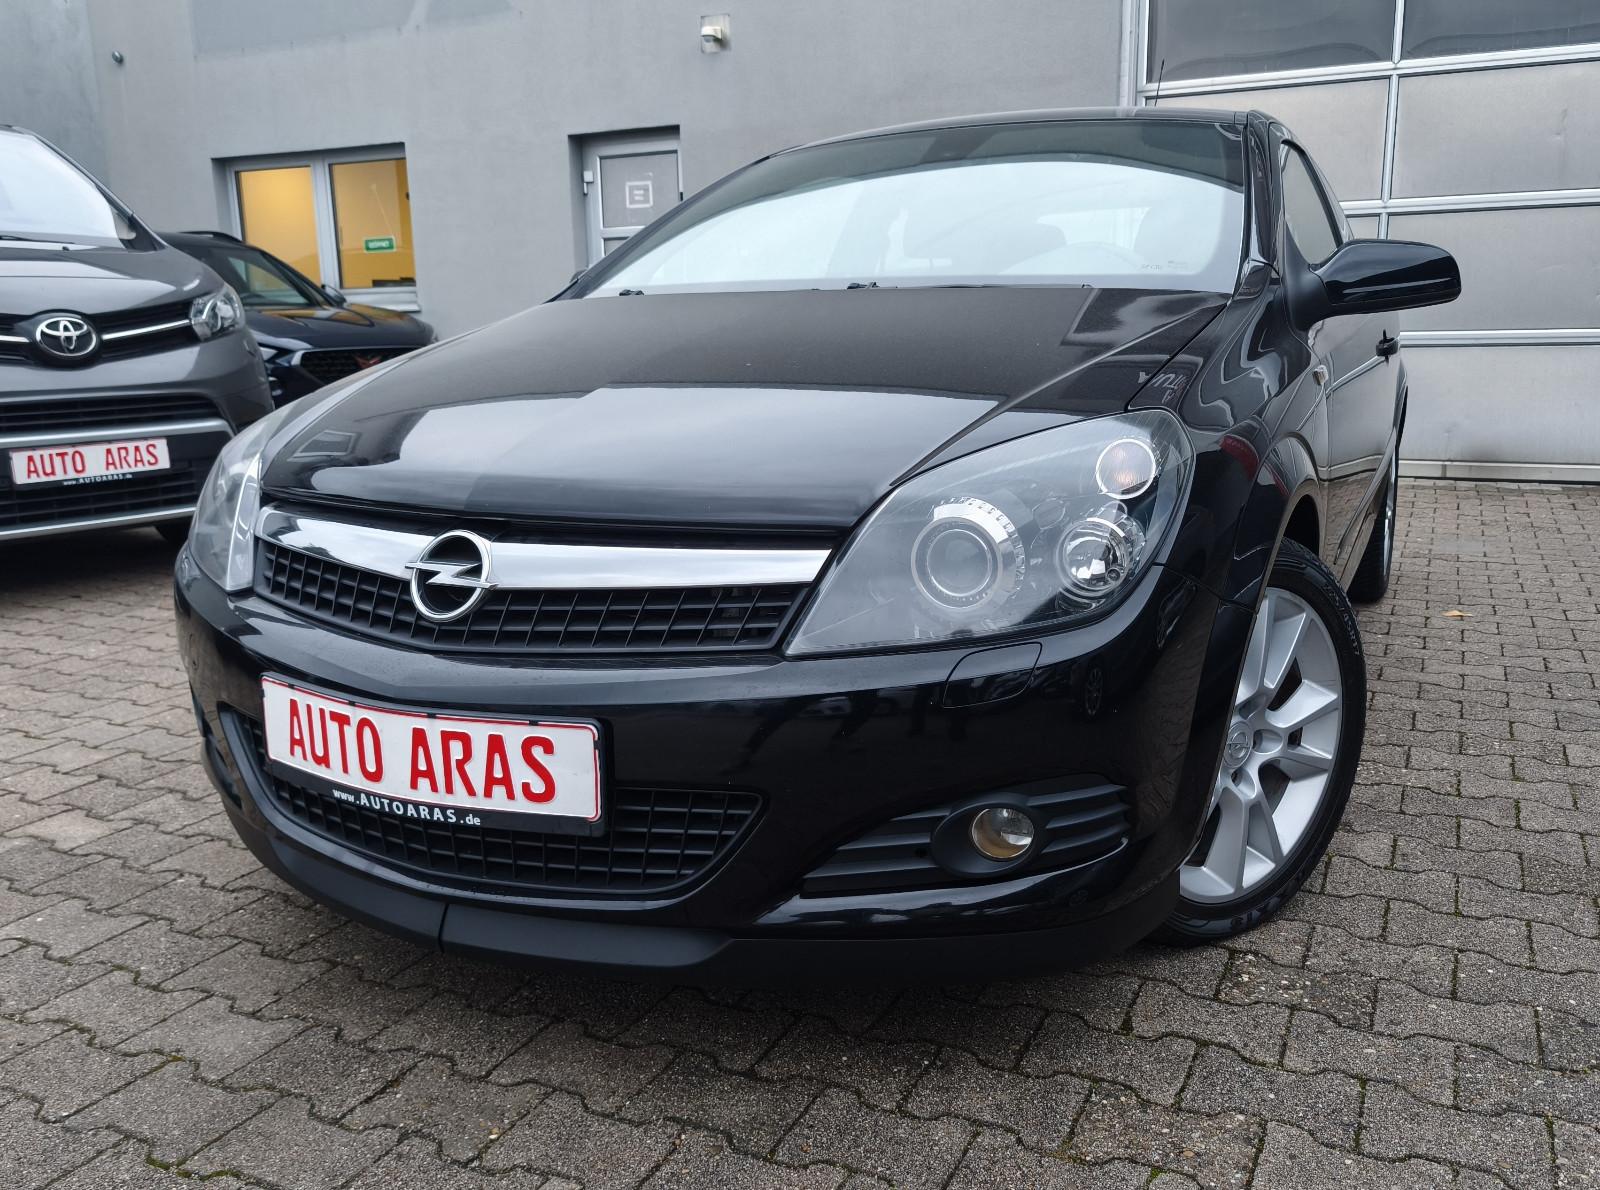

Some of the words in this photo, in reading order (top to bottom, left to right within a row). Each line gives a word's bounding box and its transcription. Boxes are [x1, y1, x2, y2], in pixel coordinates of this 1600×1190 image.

[26, 450, 86, 480] AUTO
[105, 443, 159, 471] ARAS
[289, 698, 384, 783] AUTO
[410, 727, 556, 803] ARAS
[332, 789, 481, 826] www.AUTOARAS.de
